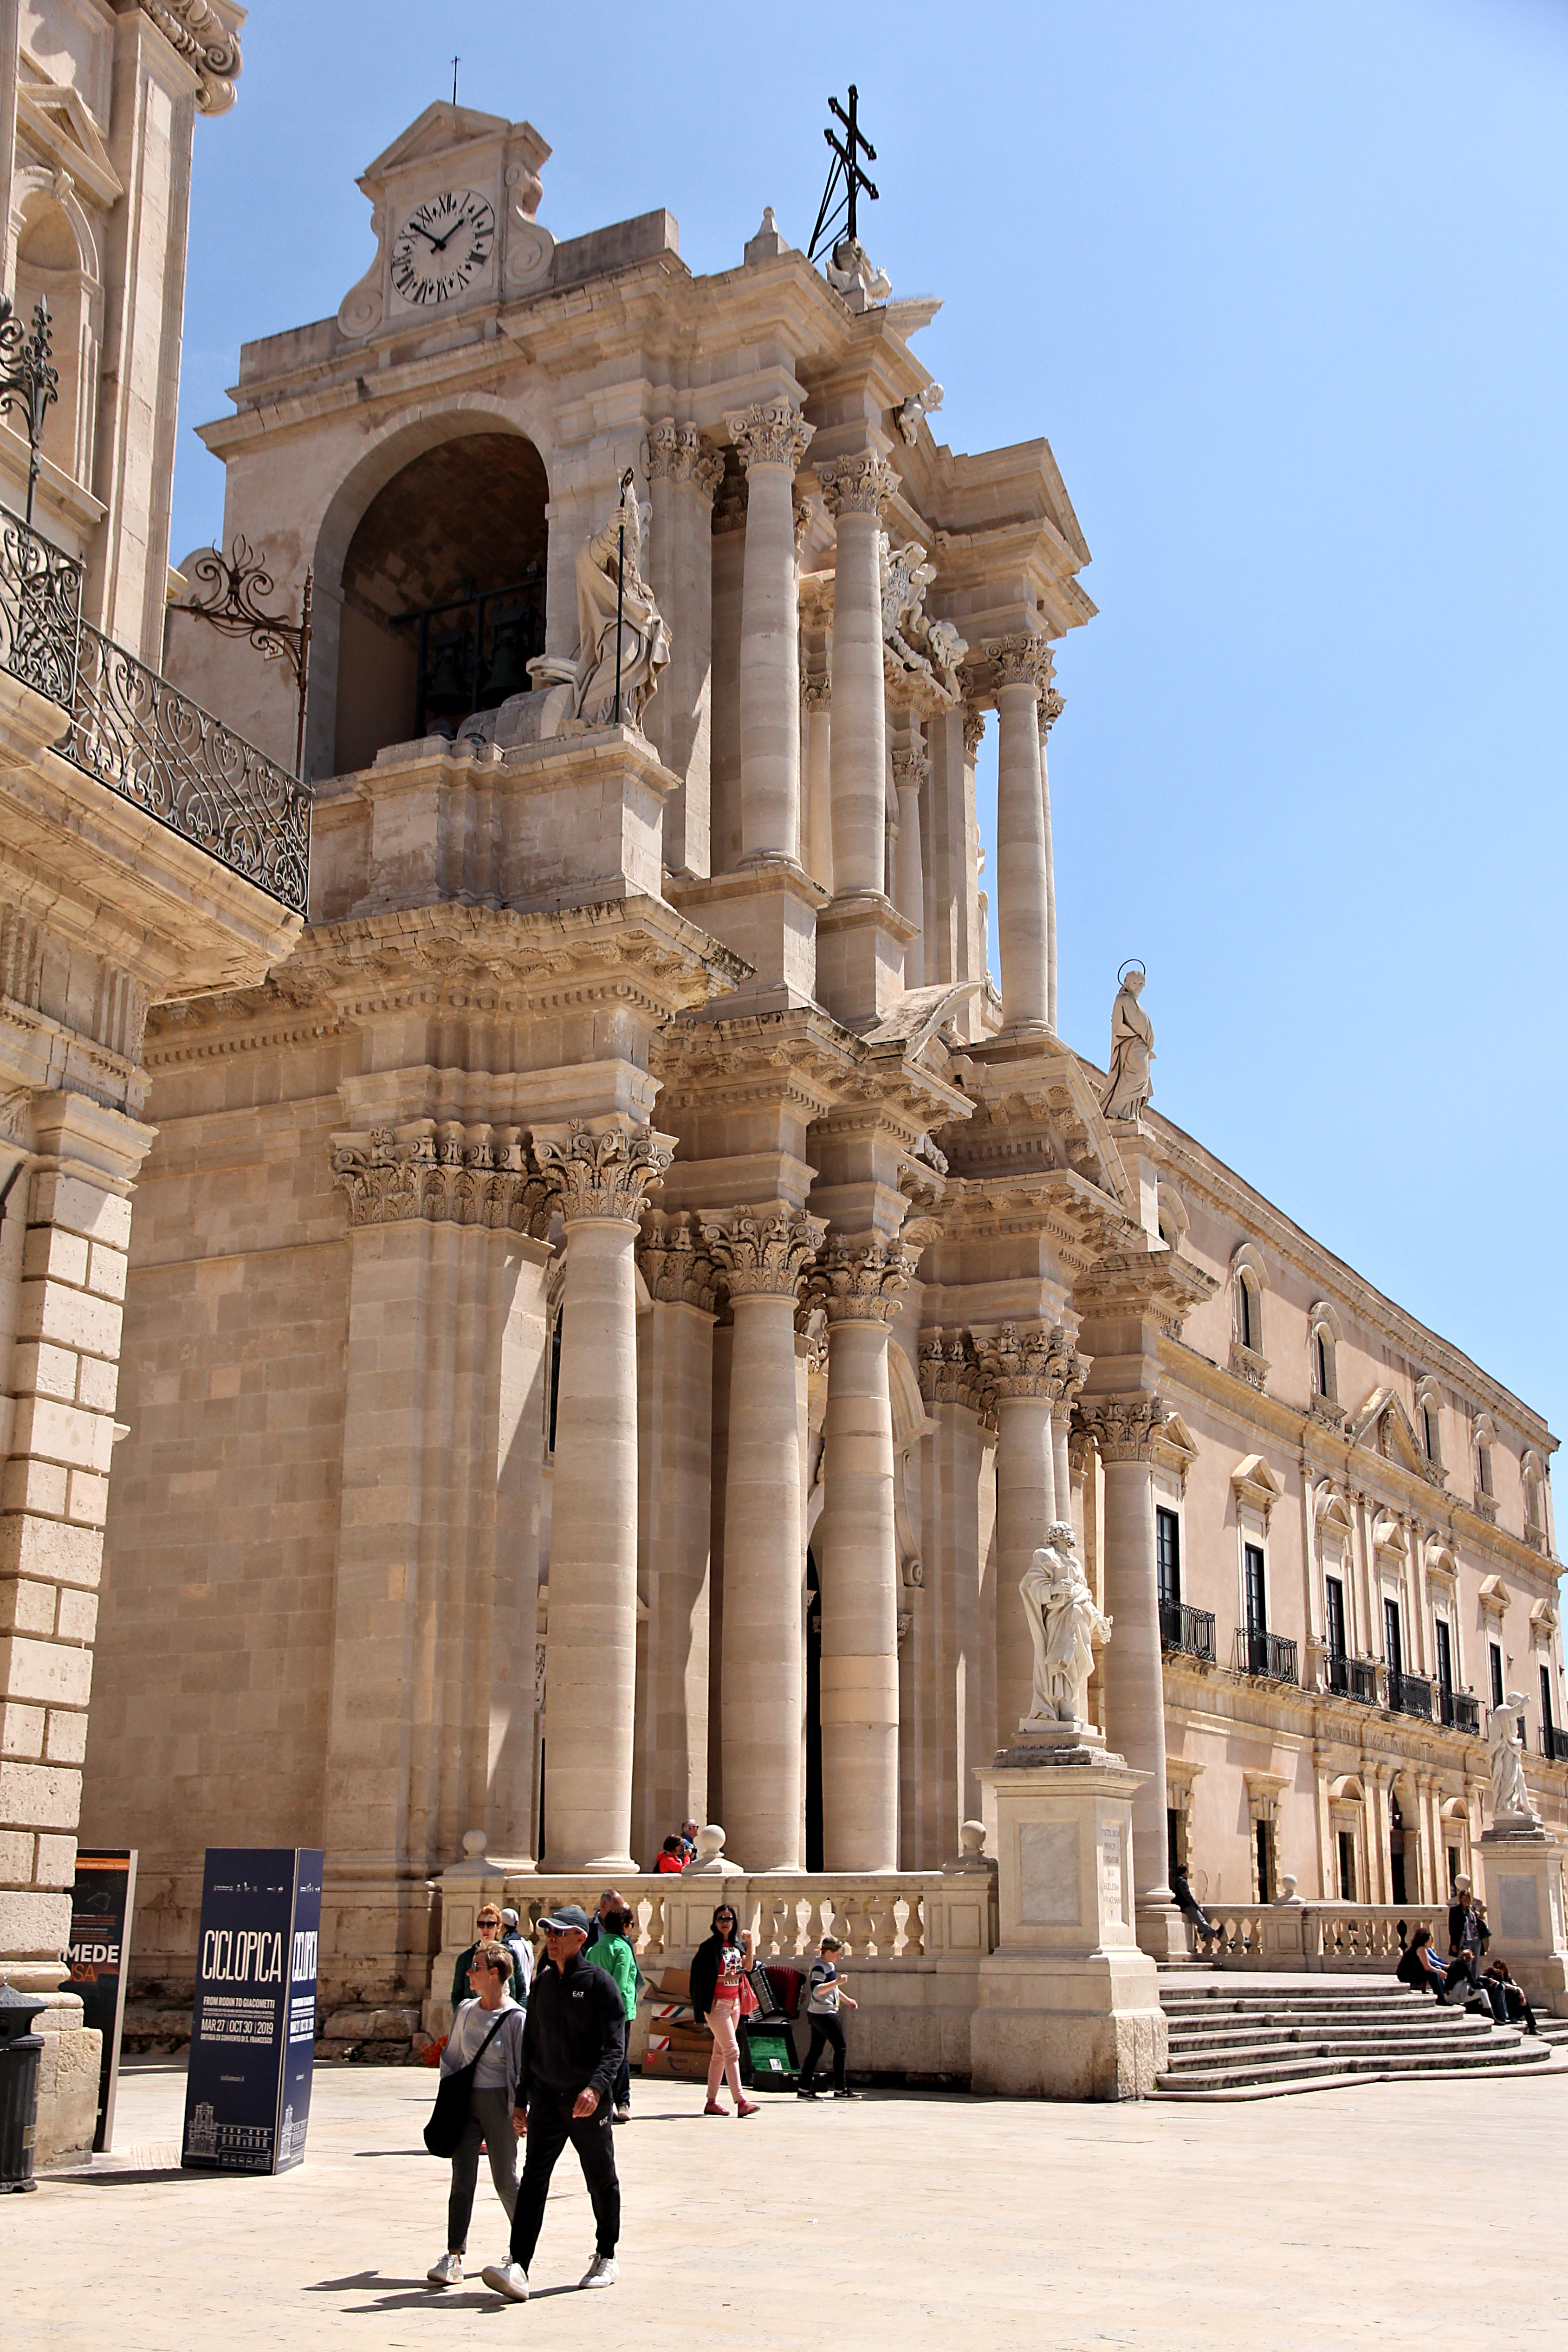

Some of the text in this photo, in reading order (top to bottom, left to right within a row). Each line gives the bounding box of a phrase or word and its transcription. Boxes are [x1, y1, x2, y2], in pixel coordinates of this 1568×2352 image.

[201, 1930, 282, 1983] CICLOPICA
[203, 1996, 275, 2009] FROM RODIN TO GIACOMETTI
[201, 2019, 274, 2035] MAR 27 OCT 30 2019
